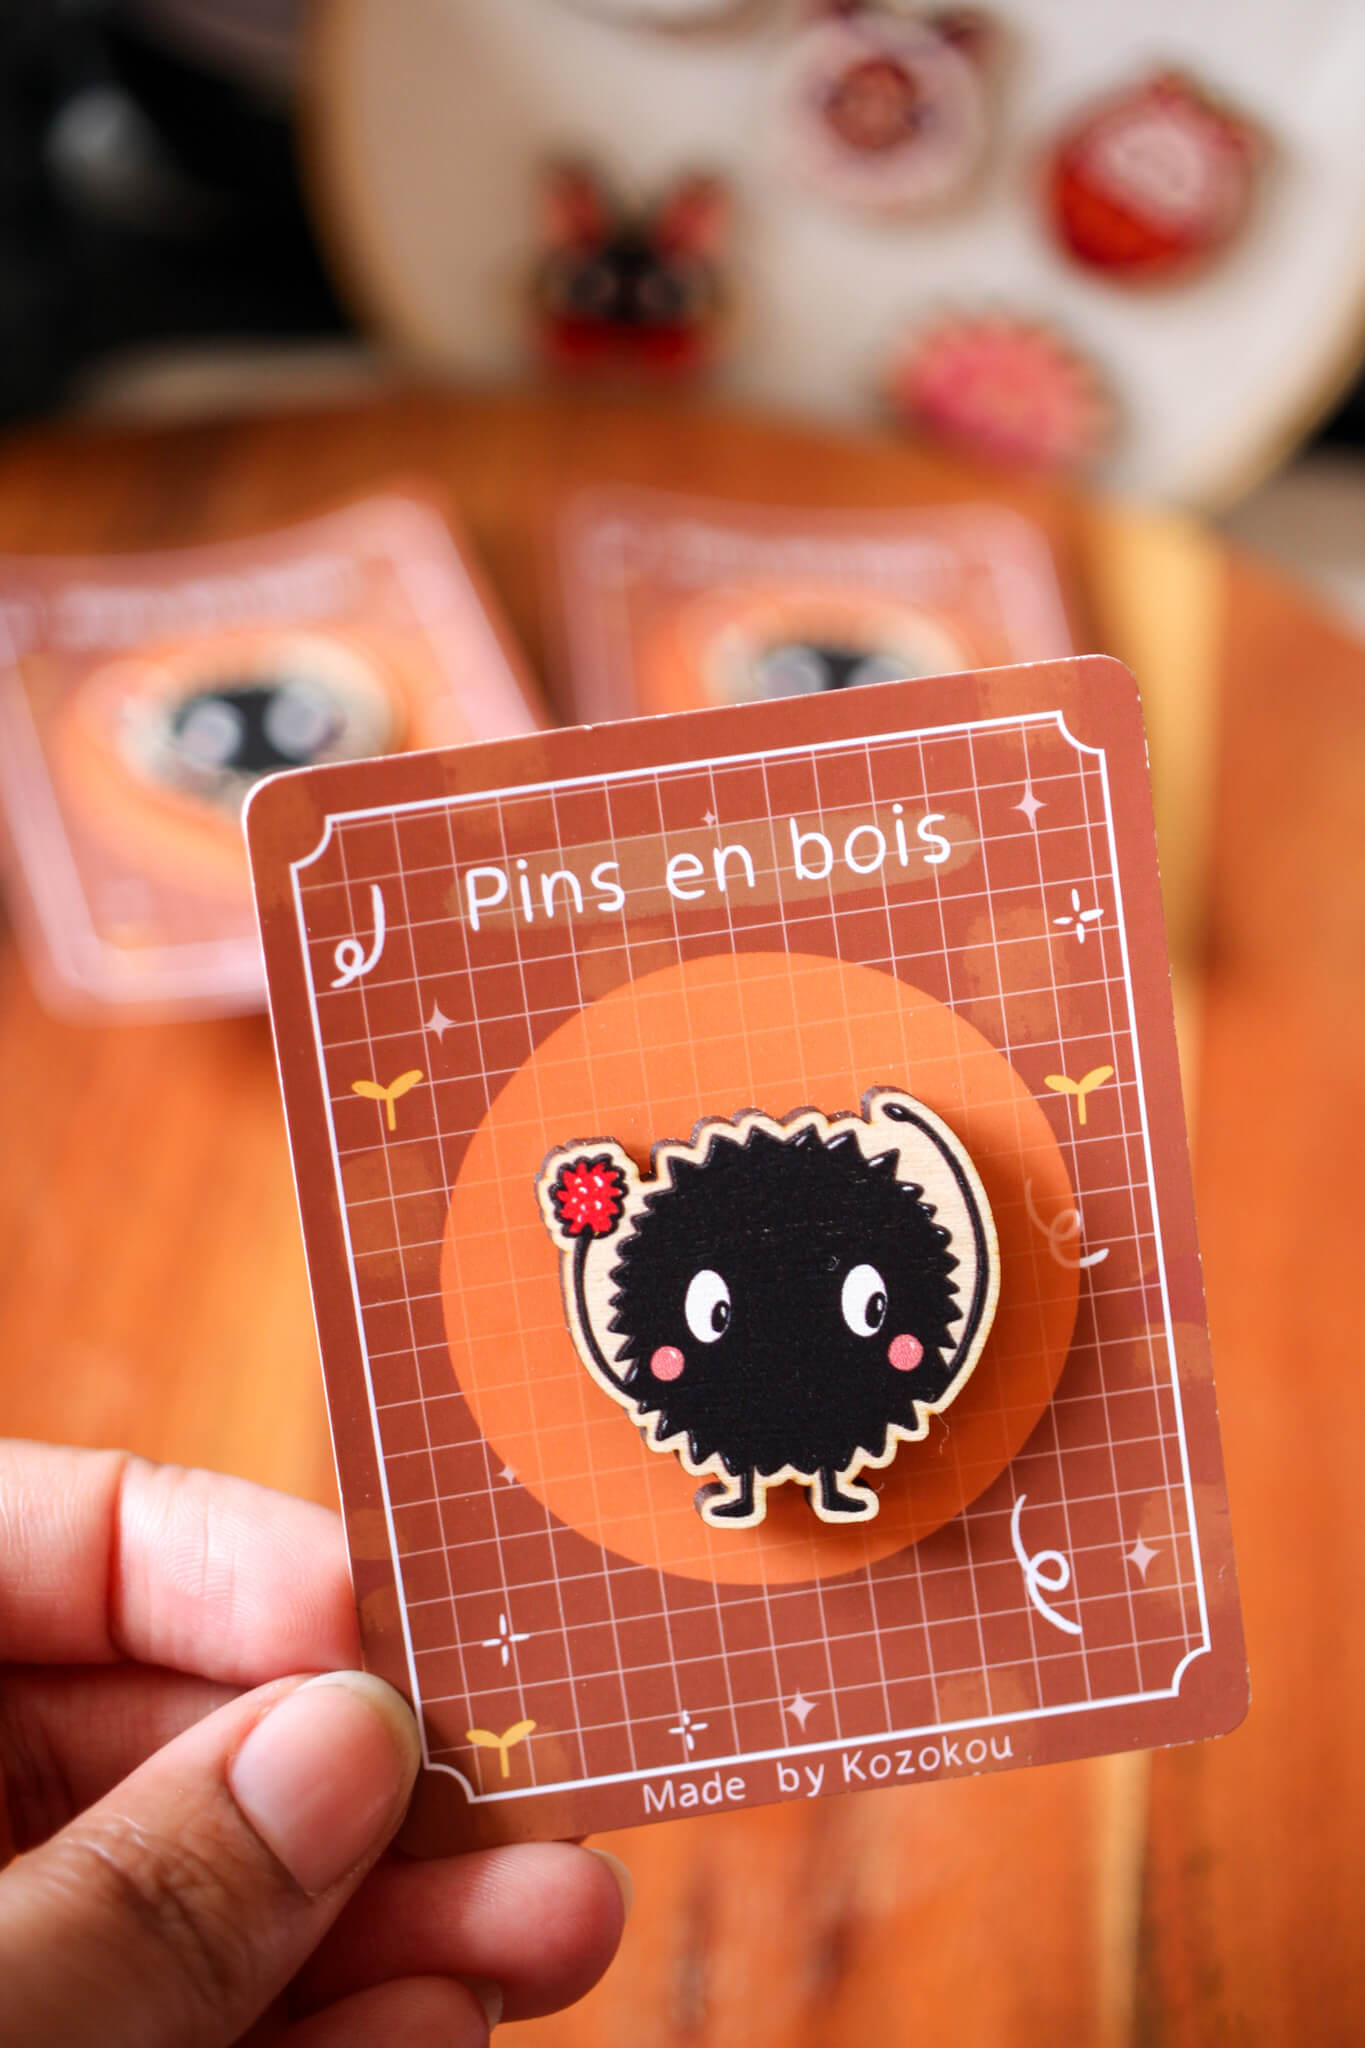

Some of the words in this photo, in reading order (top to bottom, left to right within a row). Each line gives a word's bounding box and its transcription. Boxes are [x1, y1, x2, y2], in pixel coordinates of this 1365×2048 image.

[464, 858, 626, 931] Pins
[665, 843, 756, 901] en
[788, 802, 952, 881] bois
[642, 1770, 747, 1815] Made
[775, 1760, 826, 1798] by
[841, 1734, 1014, 1784] Kozokou
